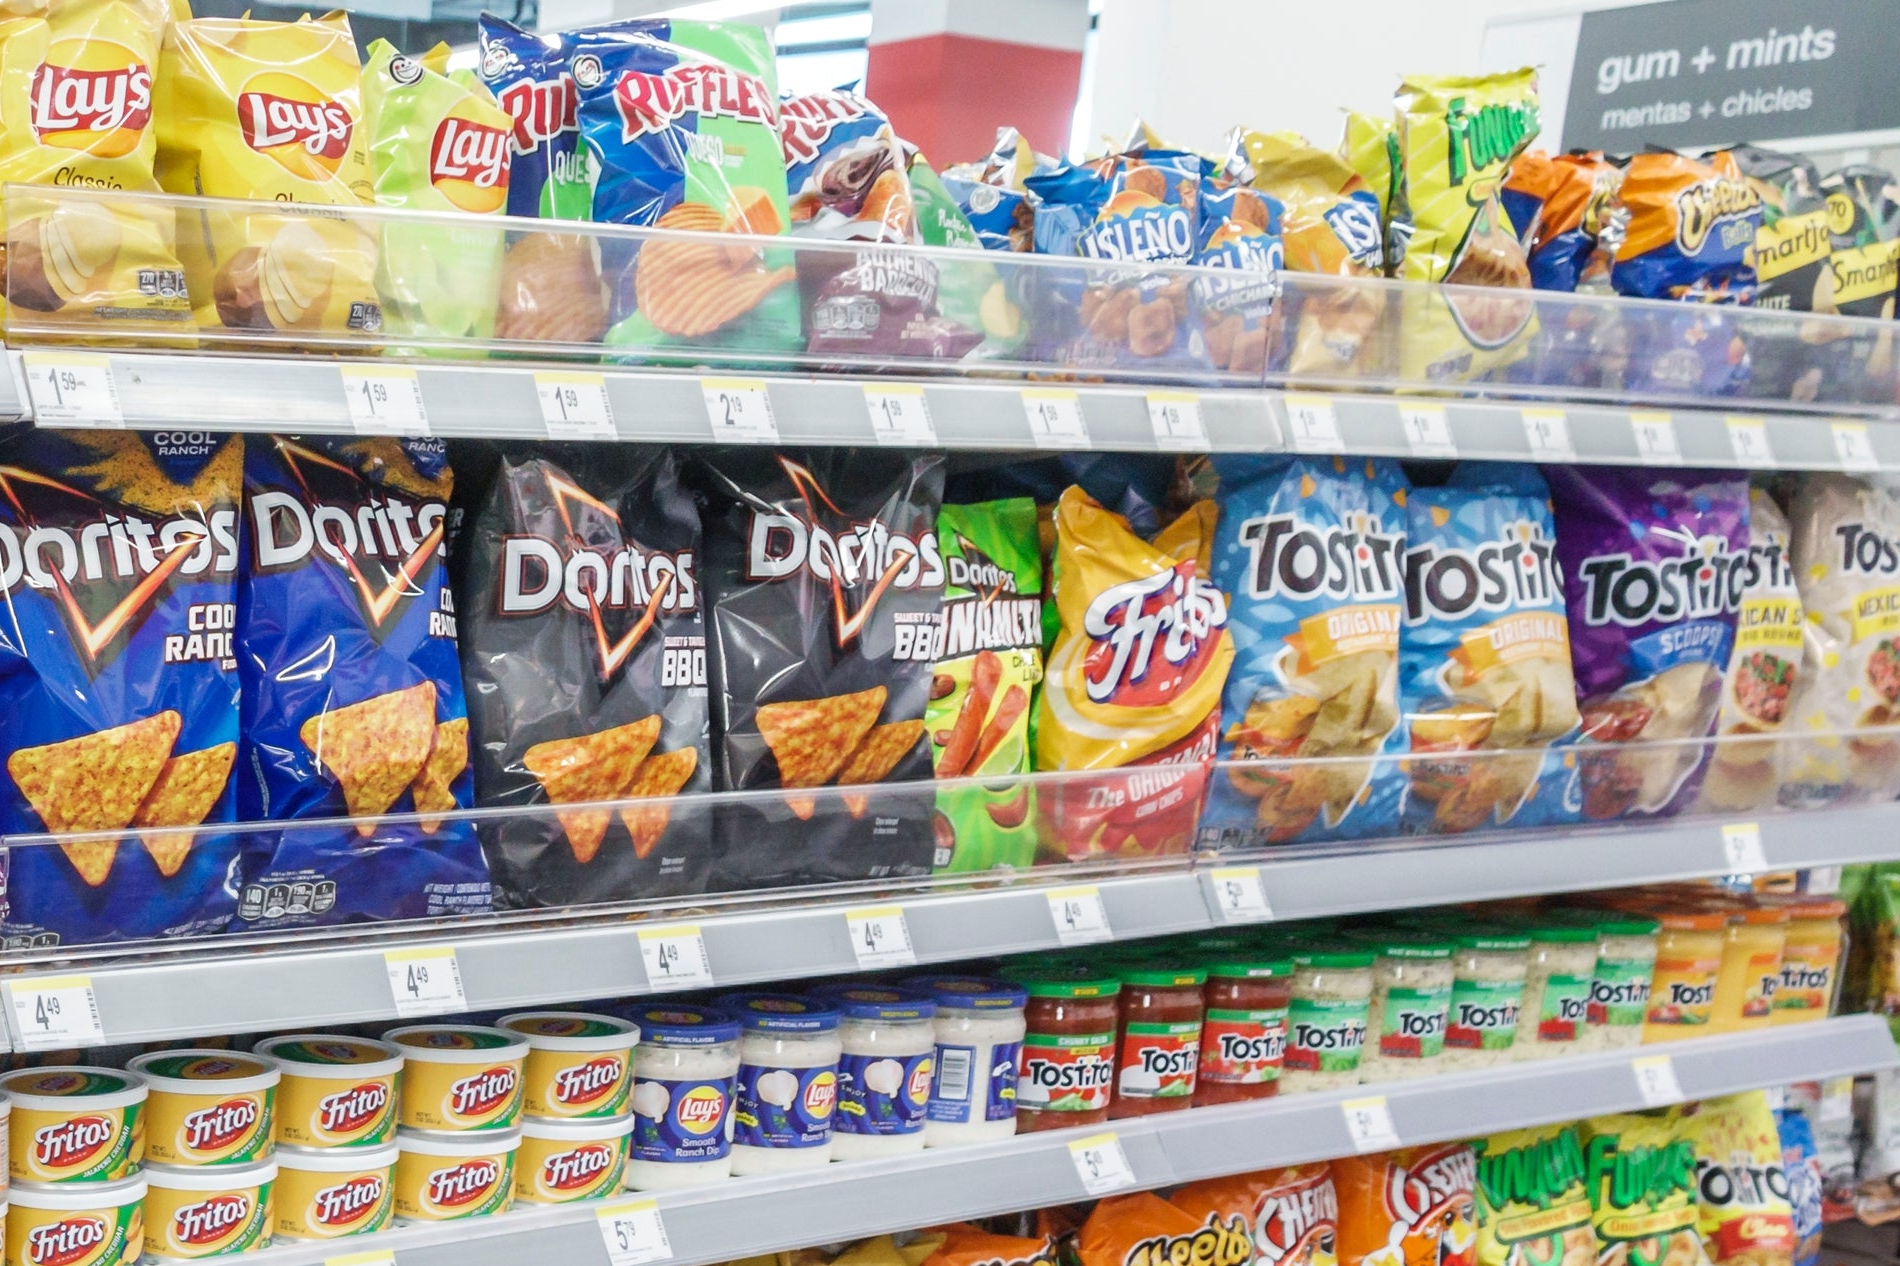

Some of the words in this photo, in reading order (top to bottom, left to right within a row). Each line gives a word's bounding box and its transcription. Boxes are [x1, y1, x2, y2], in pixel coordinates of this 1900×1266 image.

[1597, 47, 1680, 94] gum
[1726, 25, 1836, 70] mints
[36, 62, 150, 133] Lay's
[614, 68, 778, 143] RUFFLES
[1602, 101, 1691, 130] mentas
[1721, 86, 1813, 117] chicles
[248, 92, 353, 156] Lay's
[159, 445, 209, 456] RANCH
[751, 514, 945, 588] Doritos
[503, 537, 695, 613] Doritos
[950, 557, 1017, 593] Doritos
[1491, 618, 1564, 648] ORIGINAL
[557, 1057, 621, 1100] Fritos
[322, 1083, 386, 1128] Fritos
[681, 1095, 721, 1121] Lay's
[37, 1119, 111, 1162] Fritos
[676, 1147, 704, 1158] Ranch
[707, 1146, 720, 1157] Dip
[682, 1137, 715, 1147] Smooth
